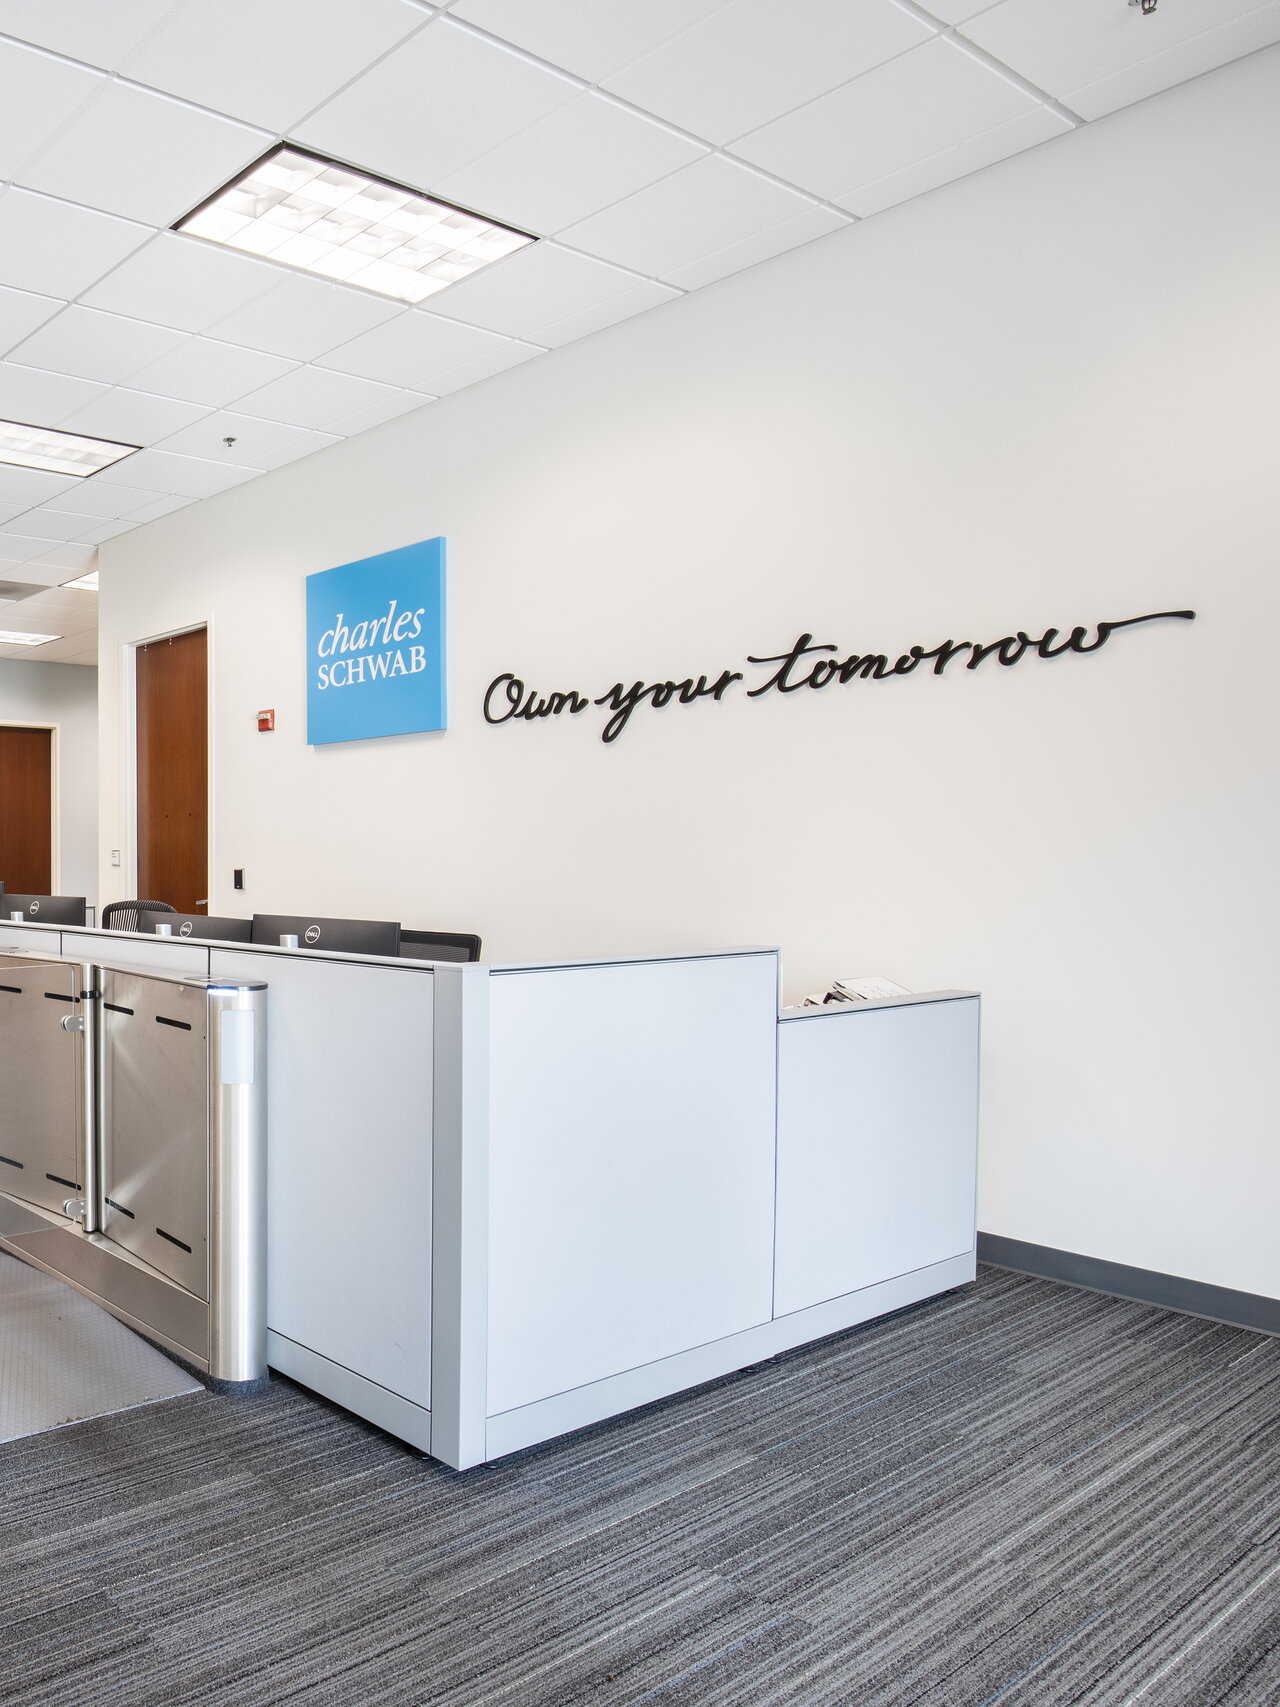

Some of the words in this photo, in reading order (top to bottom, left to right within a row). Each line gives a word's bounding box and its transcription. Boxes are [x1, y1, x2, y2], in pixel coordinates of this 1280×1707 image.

[317, 599, 426, 658] charles
[317, 645, 427, 690] SCHWAB
[483, 672, 590, 724] Own
[592, 669, 744, 743] your
[746, 610, 1196, 698] tomorrow
